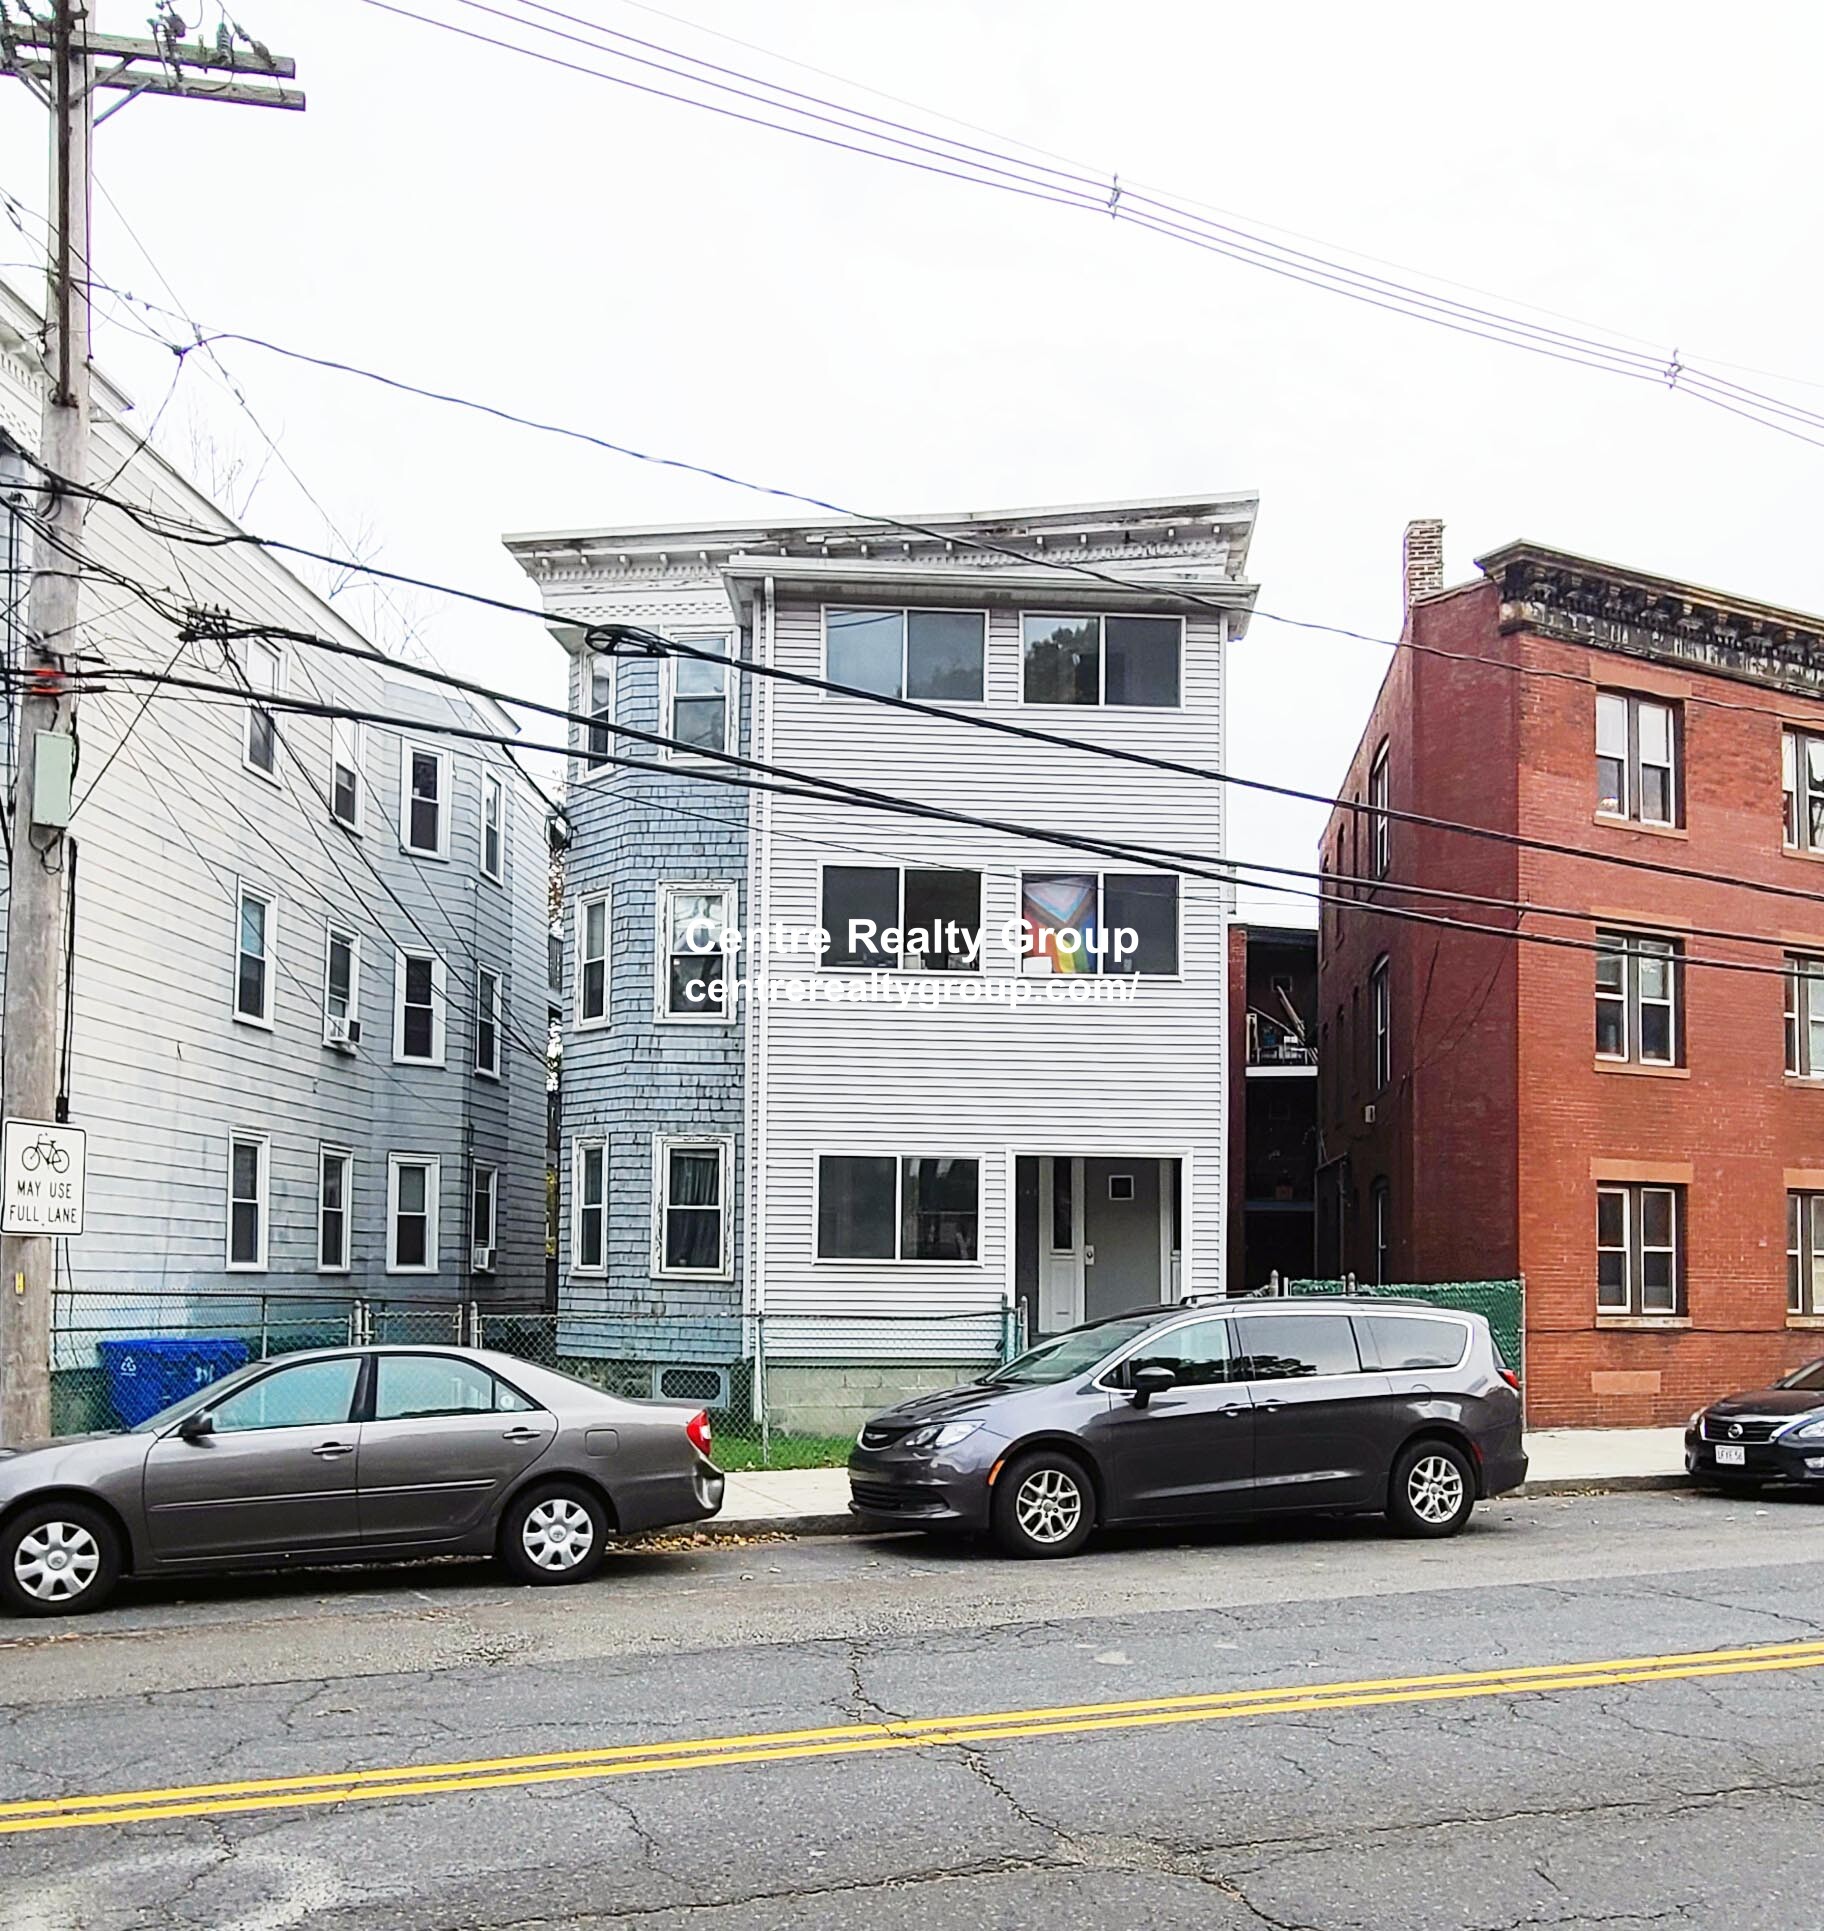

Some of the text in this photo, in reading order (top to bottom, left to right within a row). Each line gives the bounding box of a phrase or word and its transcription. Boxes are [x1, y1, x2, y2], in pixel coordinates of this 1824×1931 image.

[17, 1180, 72, 1199] MAY USE
[9, 1205, 77, 1223] FULL LANE
